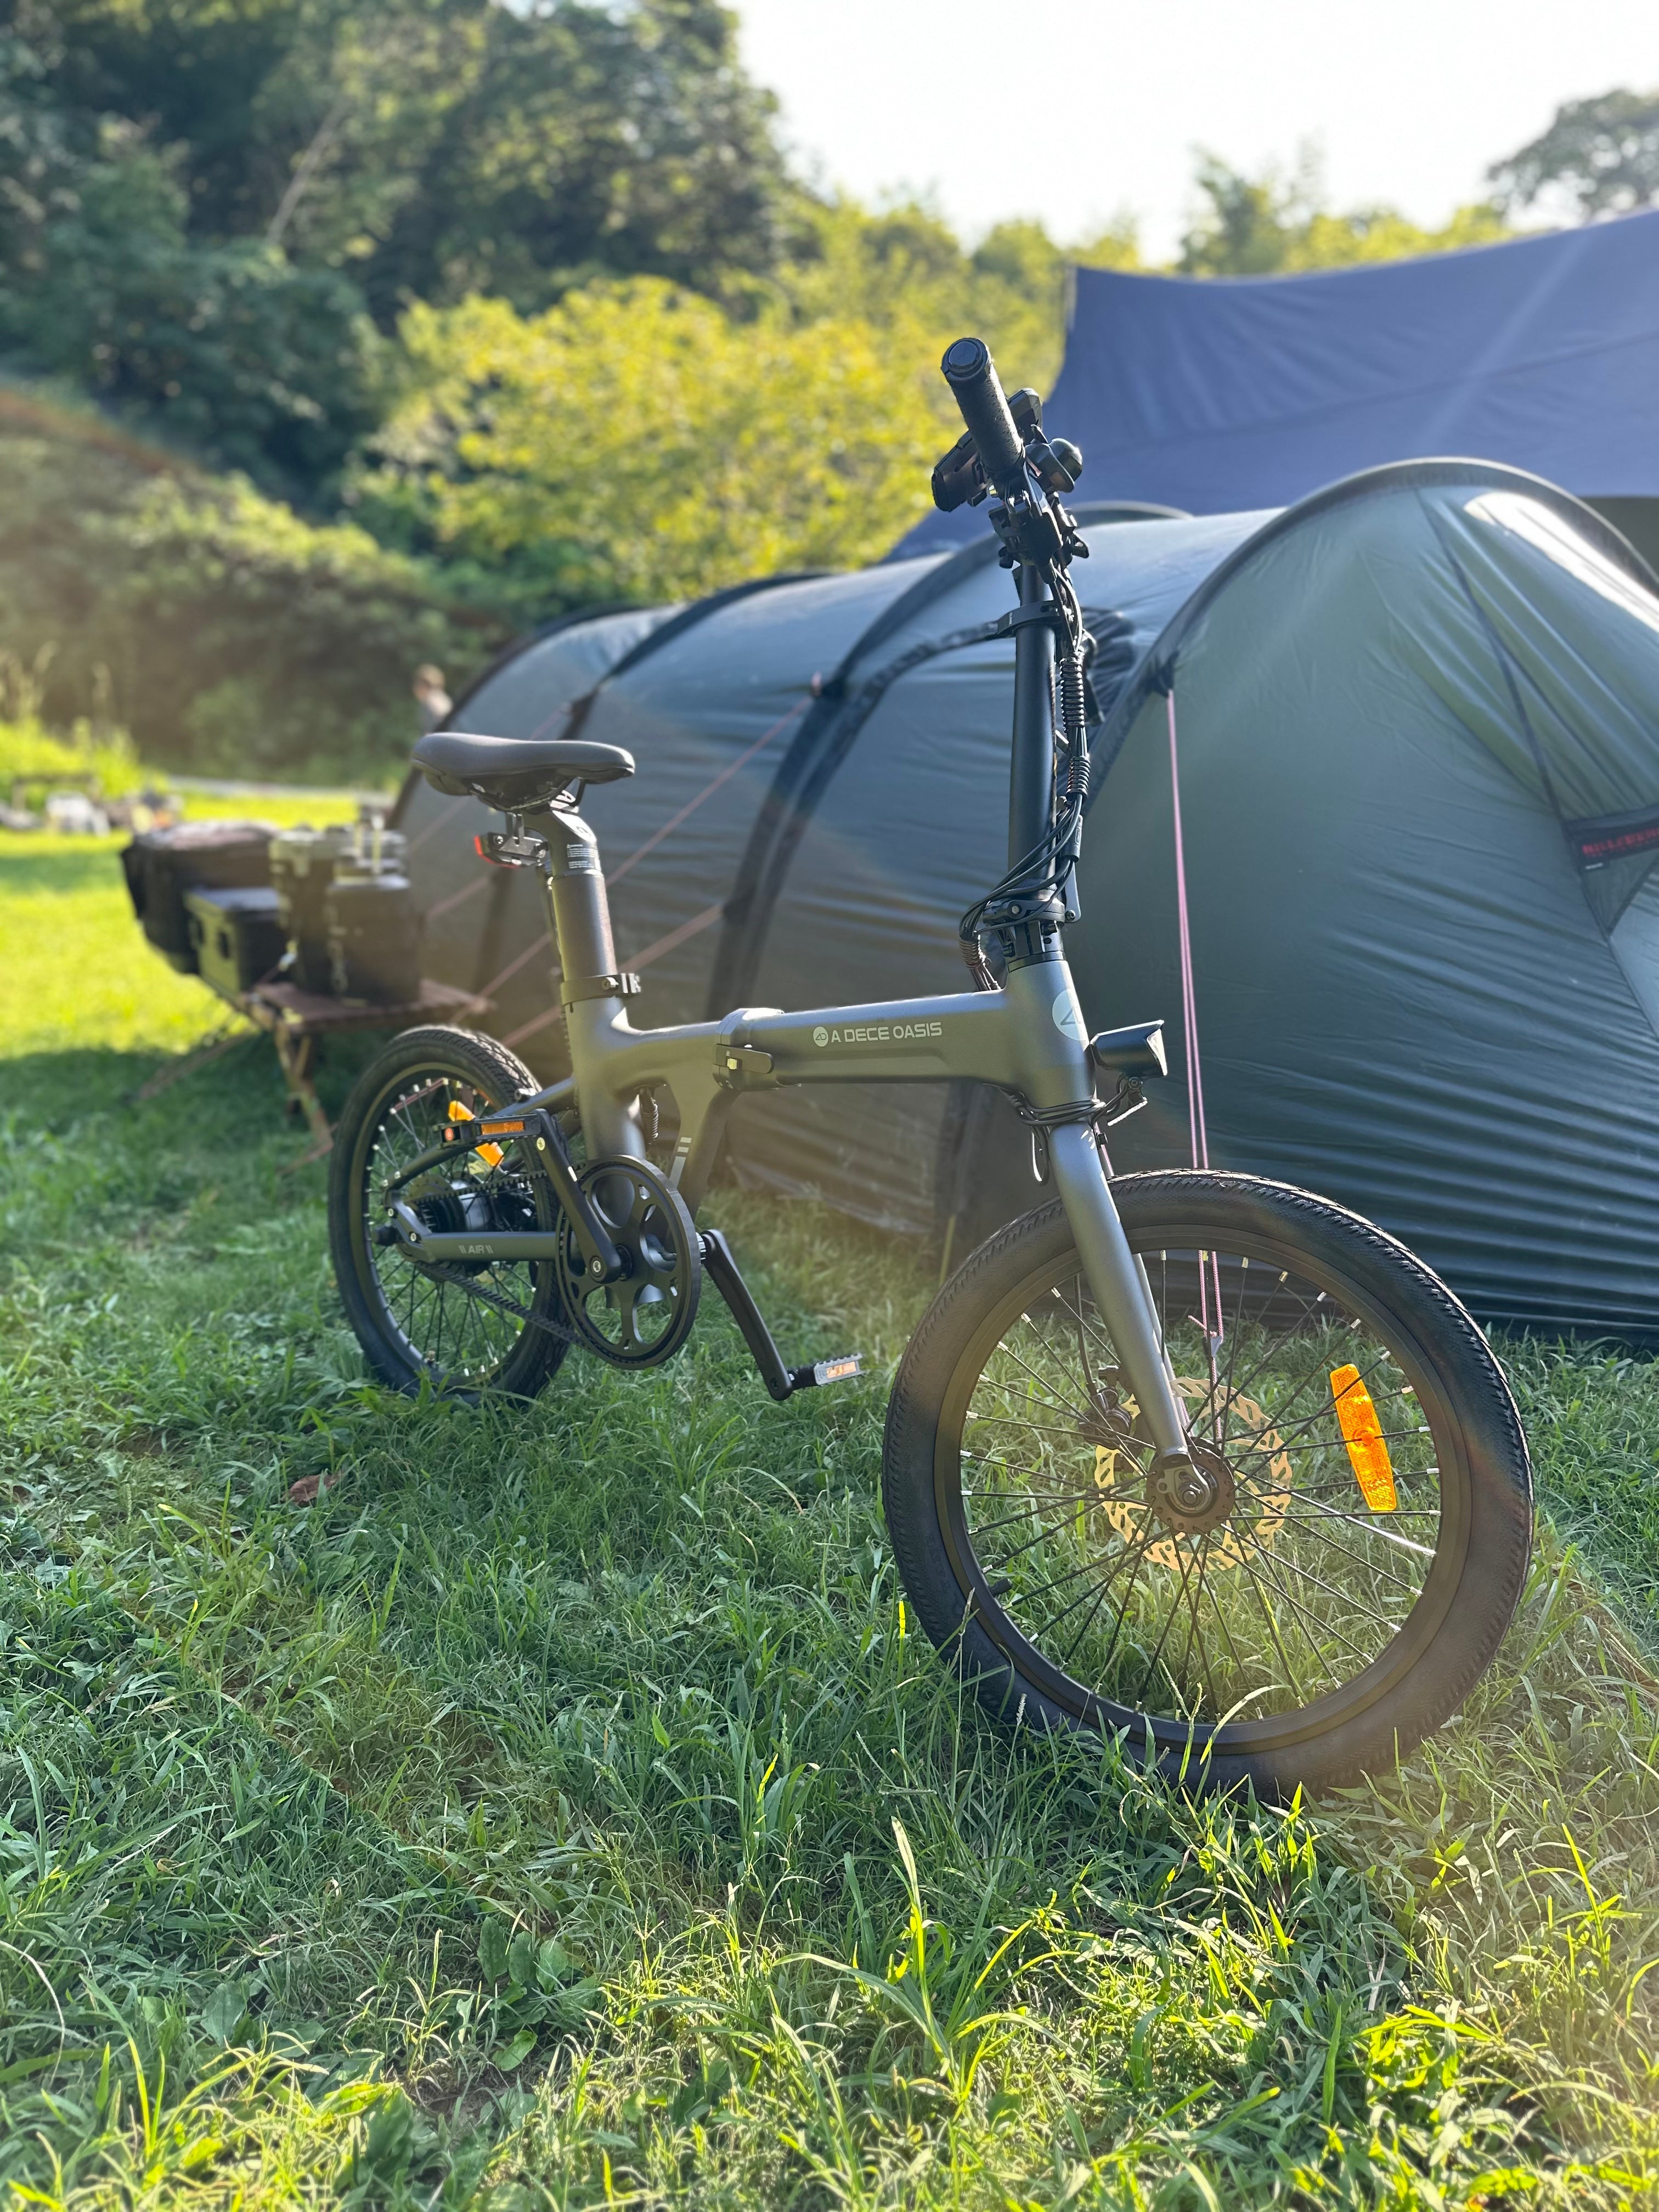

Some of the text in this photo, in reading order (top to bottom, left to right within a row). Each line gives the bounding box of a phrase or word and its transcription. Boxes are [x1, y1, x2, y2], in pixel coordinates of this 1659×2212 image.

[831, 1030, 841, 1043] A
[844, 1026, 890, 1042] DECE
[893, 1022, 943, 1039] OASIS
[468, 1245, 485, 1254] AIR
